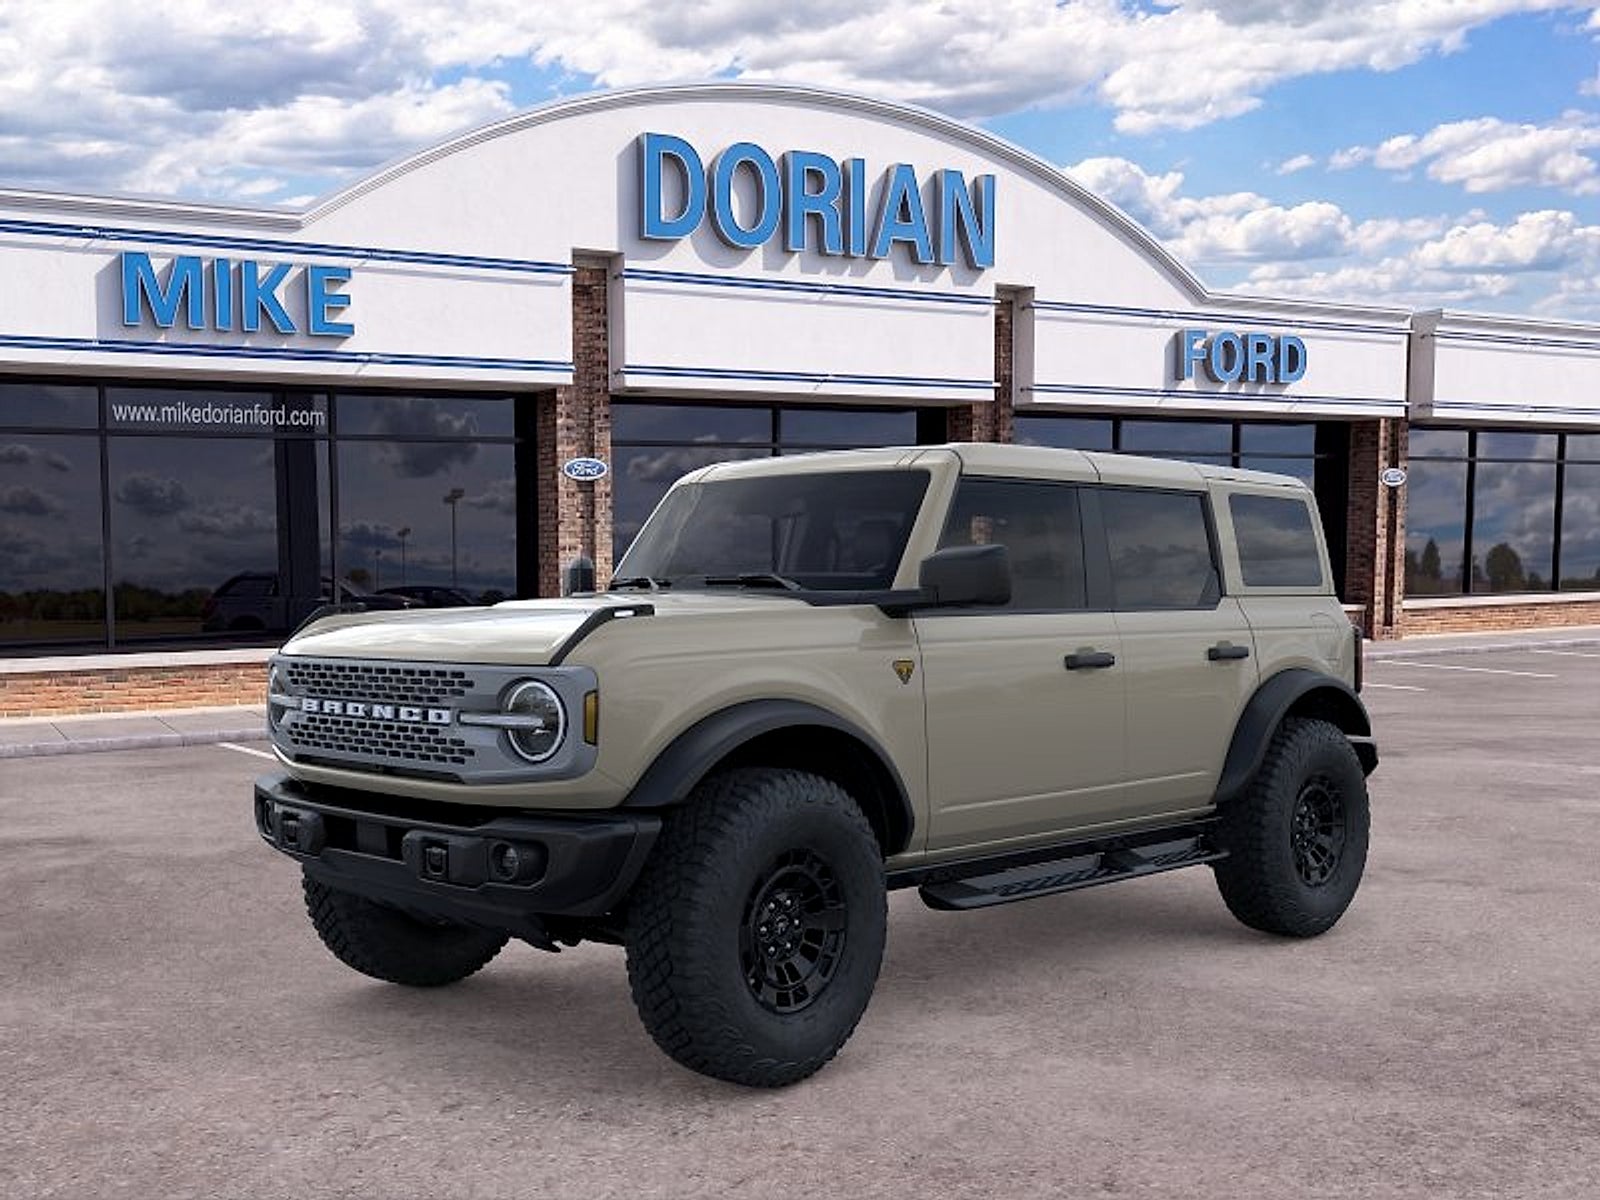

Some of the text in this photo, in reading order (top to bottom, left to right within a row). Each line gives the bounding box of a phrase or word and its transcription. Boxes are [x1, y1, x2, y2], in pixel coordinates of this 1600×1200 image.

[640, 132, 996, 270] DORIAN
[121, 251, 355, 337] MIKE
[1178, 329, 1308, 384] FORD
[111, 402, 326, 427] www.mikedorianford.com
[301, 698, 452, 723] BRONCO
